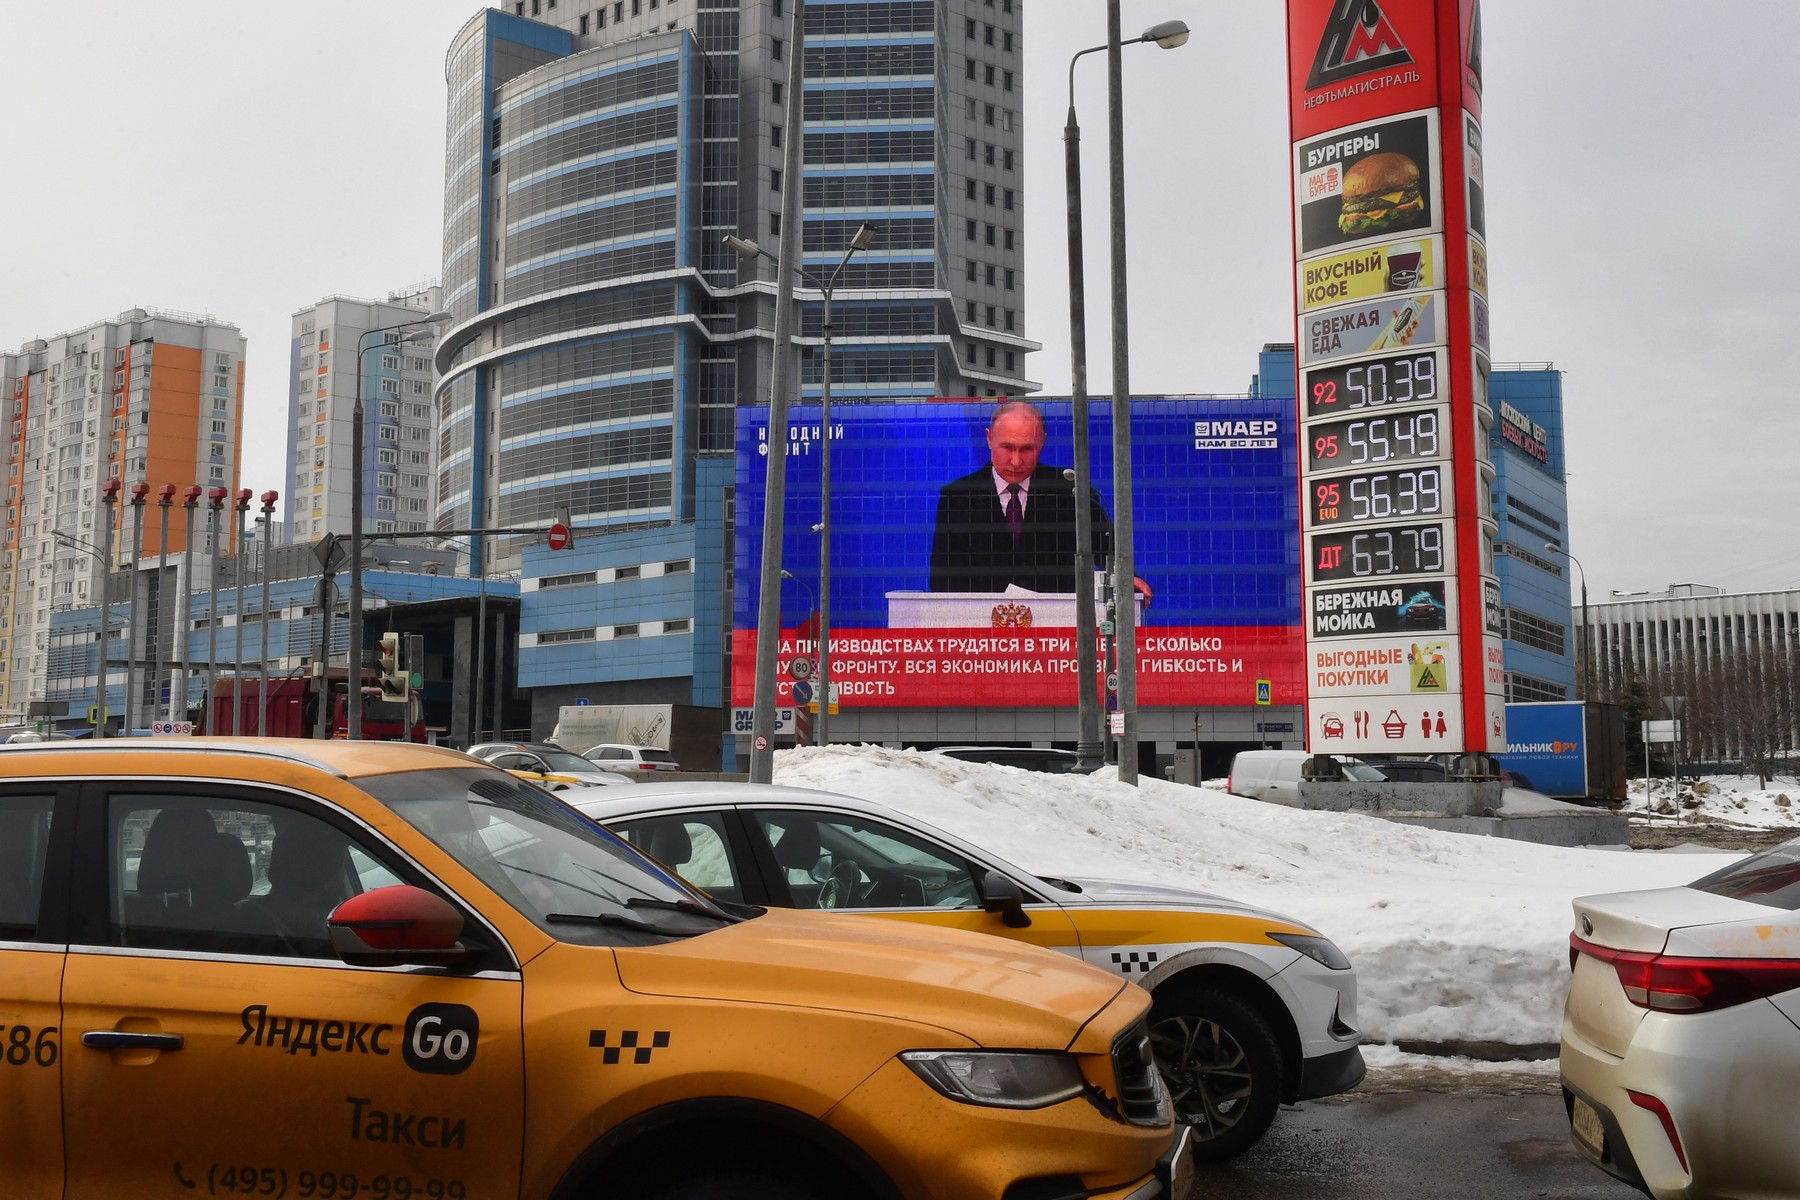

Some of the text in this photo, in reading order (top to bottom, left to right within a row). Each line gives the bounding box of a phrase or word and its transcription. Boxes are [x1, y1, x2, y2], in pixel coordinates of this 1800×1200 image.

[1303, 71, 1420, 110] НЕФТЬМАГИСТРАЛЬ
[1308, 132, 1379, 167] БУРГЕРЫ
[1309, 173, 1325, 187] МАГ
[1309, 181, 1338, 197] БУРГЕР
[1306, 251, 1381, 285] ВКУСНЫЙ
[1307, 280, 1347, 303] КОФЕ
[1311, 309, 1379, 337] СВЕЖАЯ
[1312, 333, 1342, 354] ЕДА
[1313, 356, 1435, 409] 92 50.39
[1212, 421, 1278, 436] МАЕР
[1315, 413, 1437, 464] 95 55.49
[1250, 439, 1274, 447] ЛЕТ
[1316, 470, 1440, 519] 95 56.39
[1320, 507, 1338, 520] EVO
[1318, 527, 1442, 576] ДТ 63.79
[1316, 589, 1403, 612] БЕРЕЖНАЯ
[1316, 610, 1376, 632] МОЙКА
[938, 638, 1019, 655] ТРУДЯТСЯ
[1024, 638, 1035, 652] В
[1039, 638, 1070, 652] ТРИ
[1145, 637, 1222, 652] СКОЛЬКО
[795, 662, 808, 673] 80
[832, 659, 900, 674] ФРОНТУ.
[905, 659, 937, 674] ВСЯ
[941, 659, 1044, 673] ЭКОНОМИКА
[1142, 658, 1228, 673] ГИБКОСТЬ
[1232, 658, 1243, 673] И
[1316, 648, 1403, 668] ВЫГОДНЫЕ
[1108, 677, 1117, 687] 80
[1317, 669, 1389, 688] ПОКУПКИ
[237, 1004, 393, 1057] Яндекс
[412, 1015, 470, 1061] Go
[0, 1024, 59, 1067] 86
[346, 1096, 466, 1150] Такси
[208, 1163, 466, 1200] (495) 999-99-99
